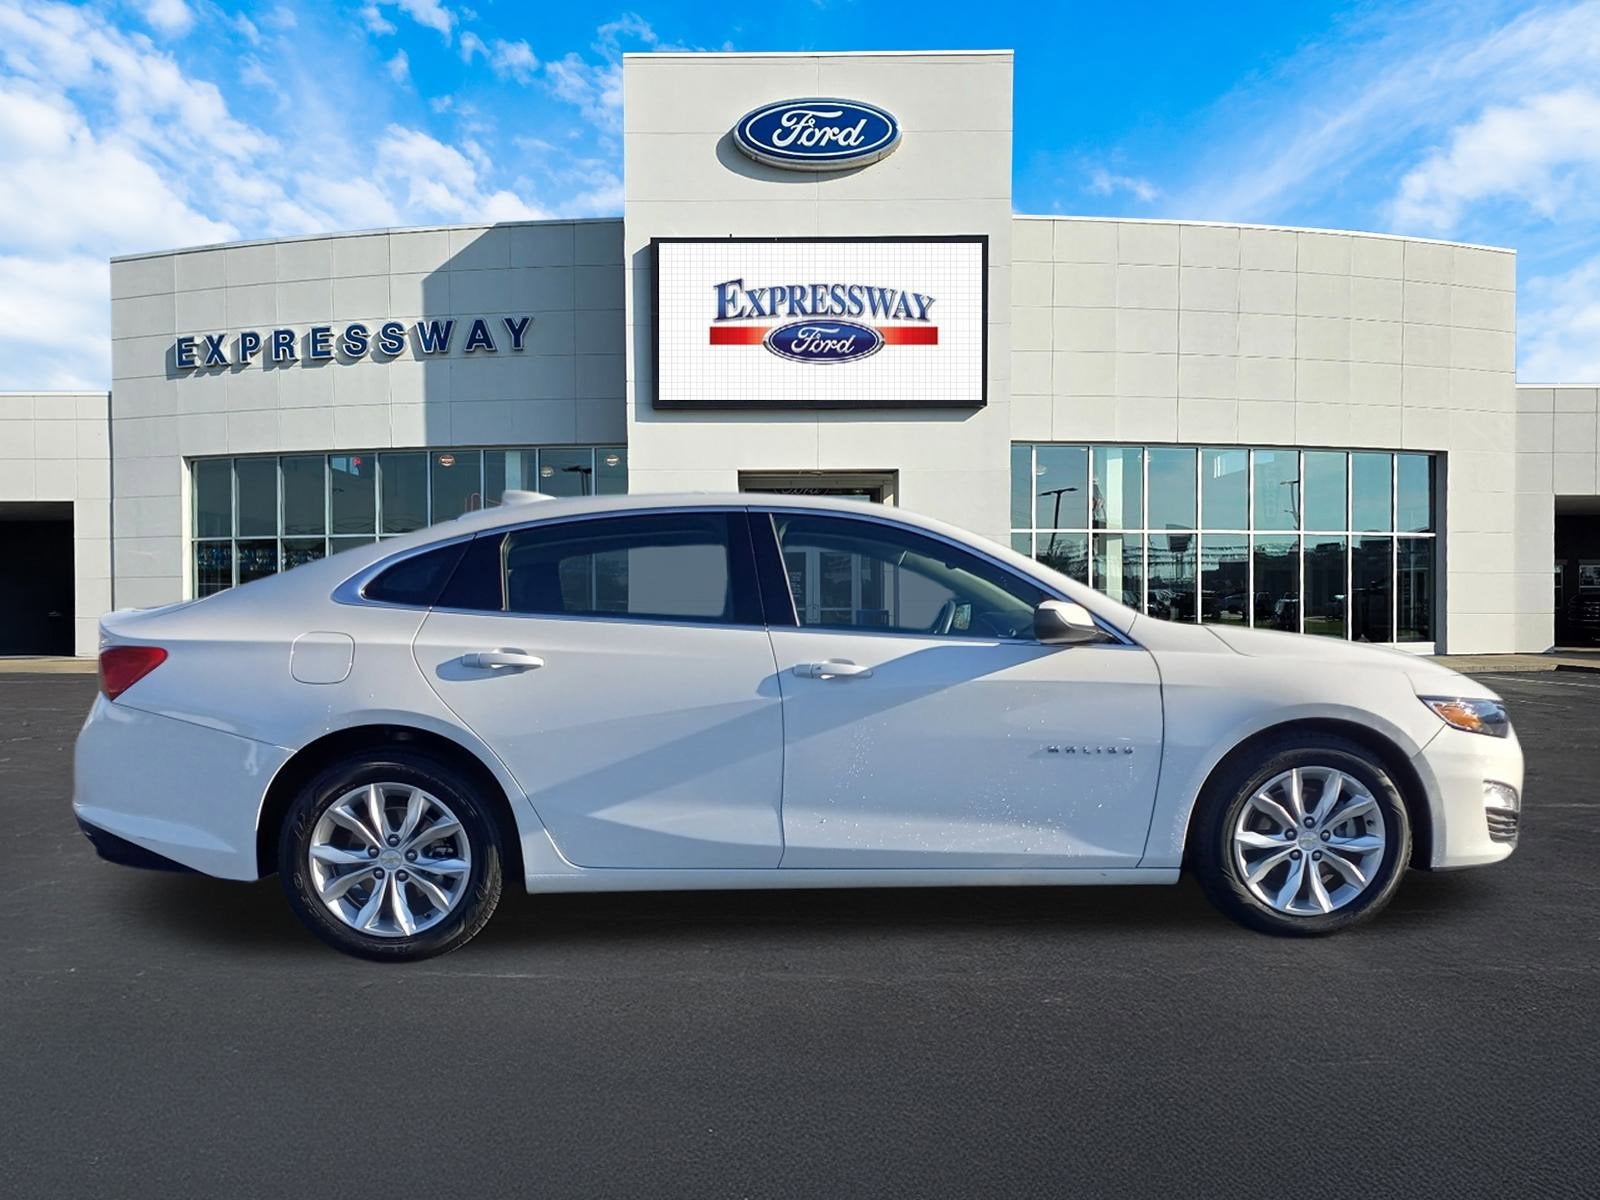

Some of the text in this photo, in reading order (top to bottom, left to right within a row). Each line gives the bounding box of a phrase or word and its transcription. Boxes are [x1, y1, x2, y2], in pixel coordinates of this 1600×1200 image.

[772, 110, 865, 148] Ford
[713, 278, 935, 323] EXPRESSWAY
[175, 315, 533, 369] EXPRESSWAY
[791, 327, 856, 355] Ford
